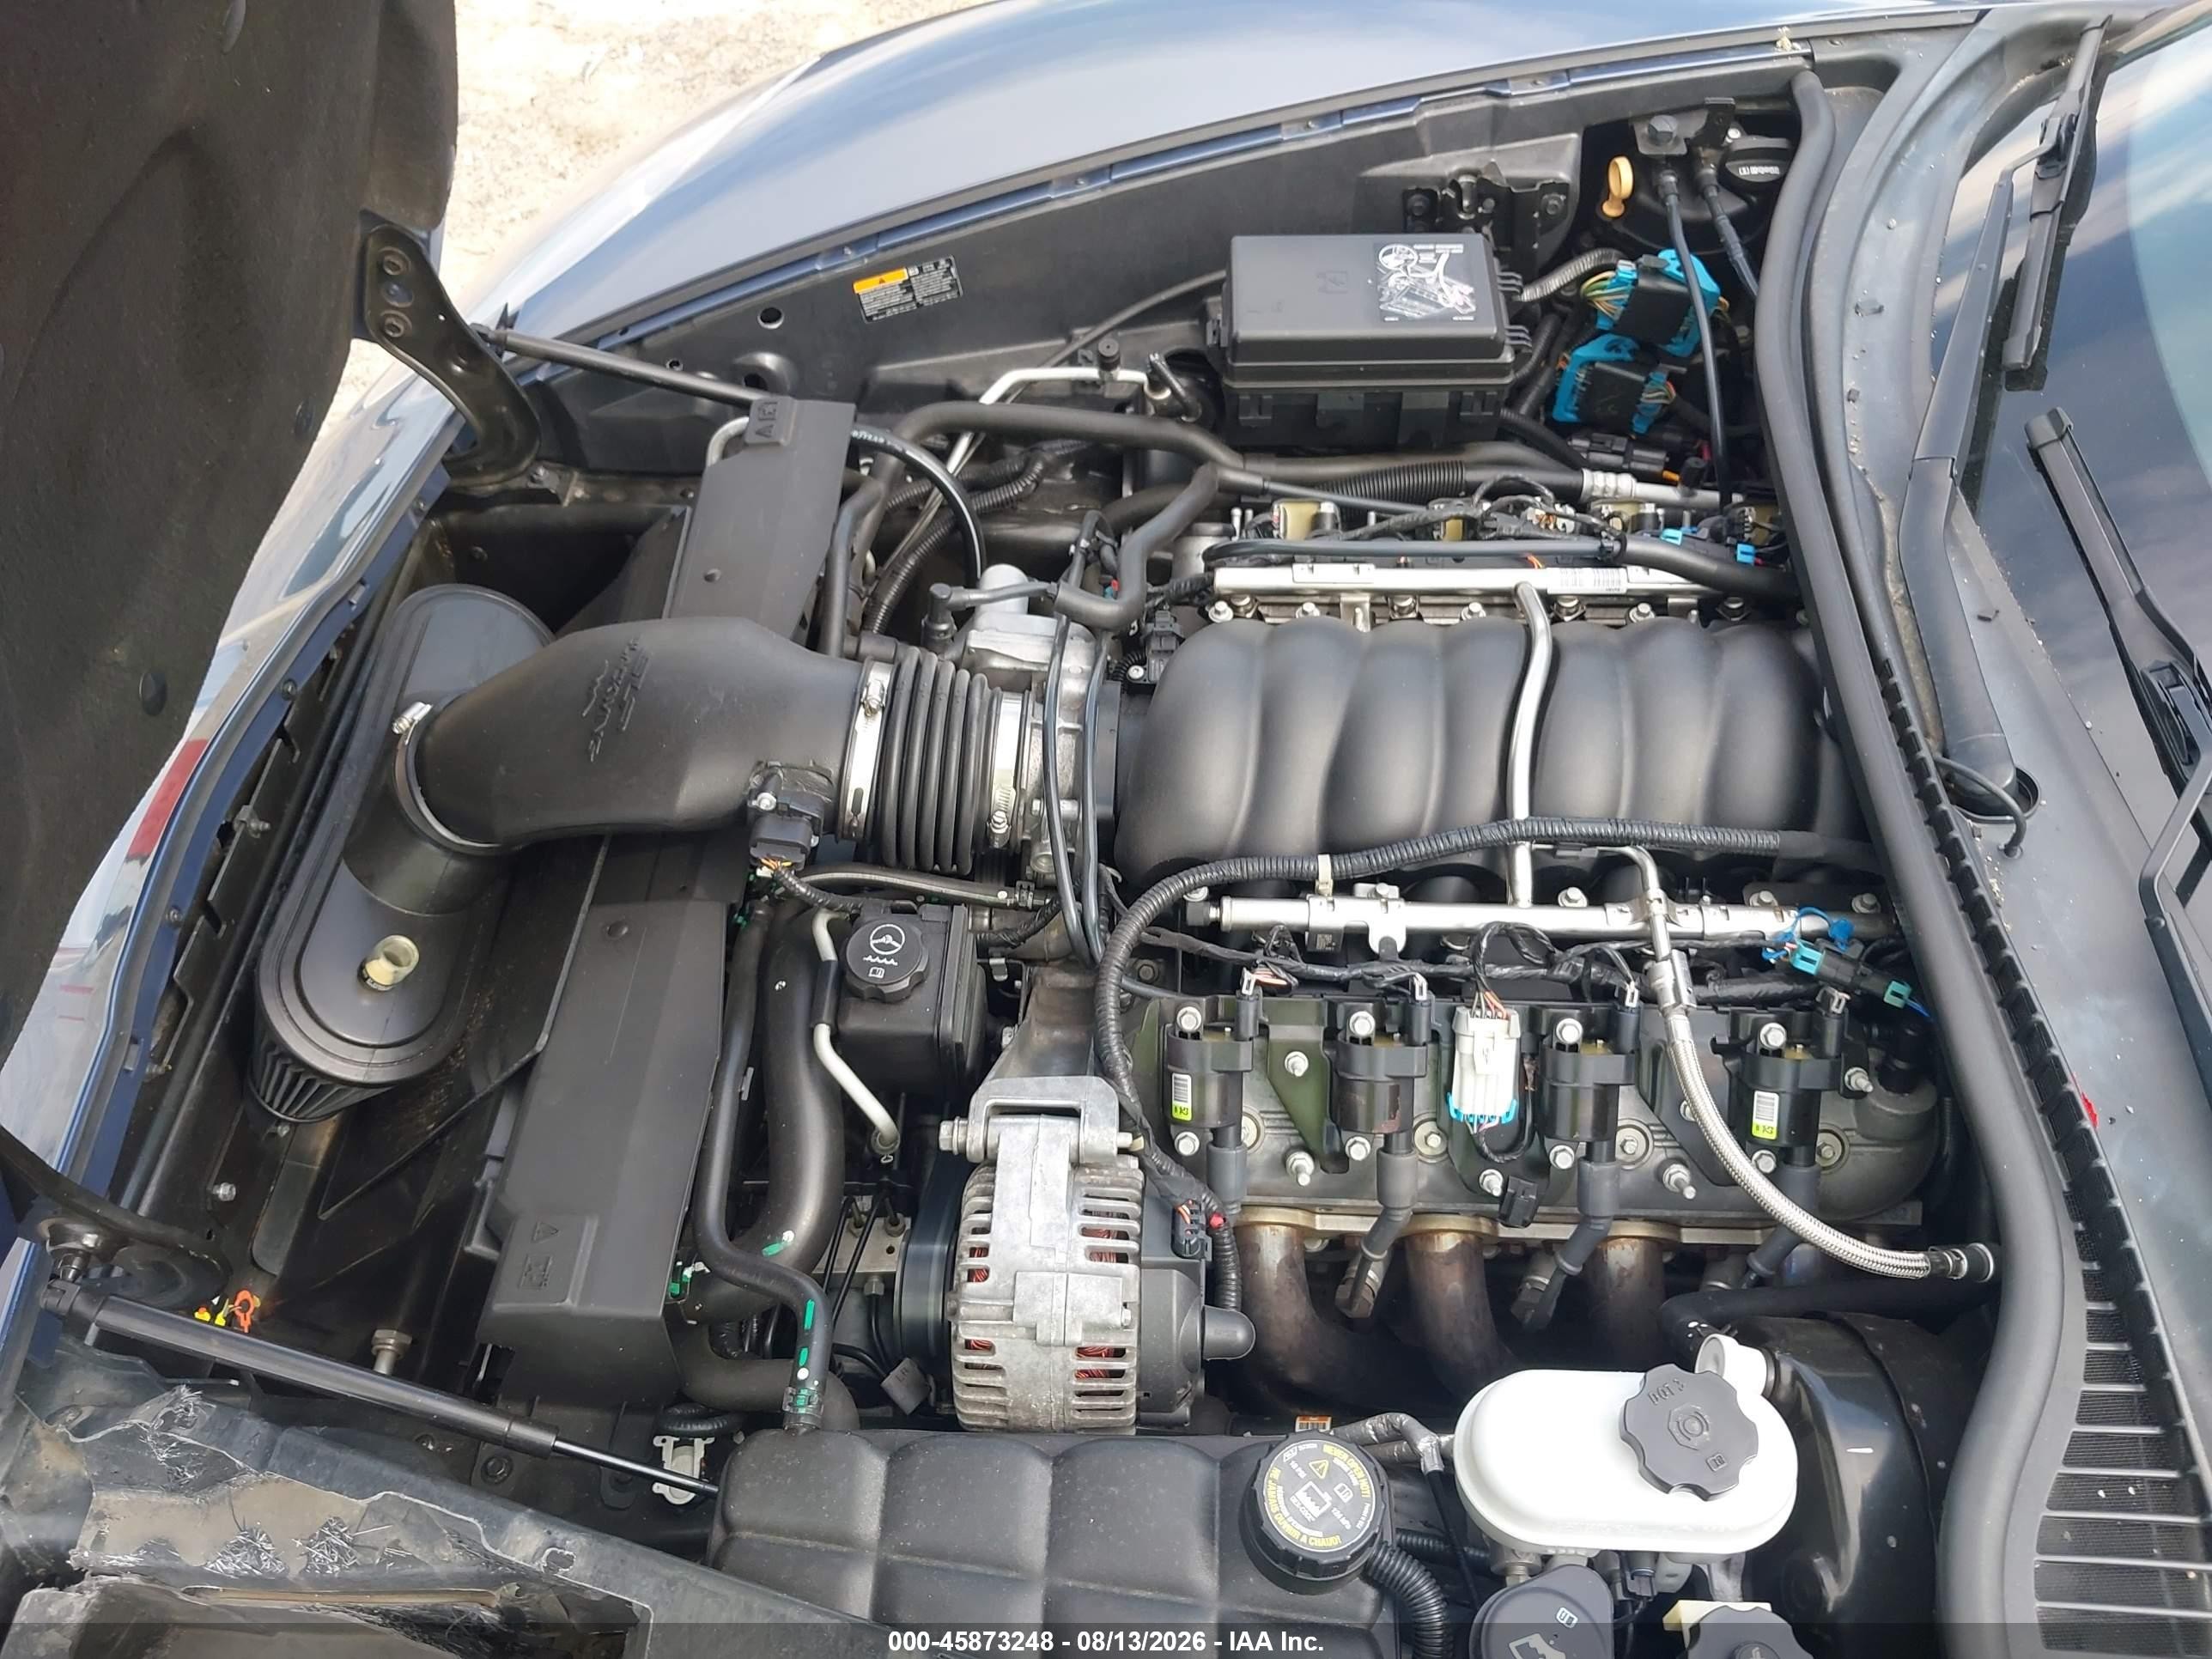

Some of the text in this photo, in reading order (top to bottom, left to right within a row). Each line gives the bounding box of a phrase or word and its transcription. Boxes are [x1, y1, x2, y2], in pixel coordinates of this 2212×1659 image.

[1269, 1467, 1281, 1480] NE
[1323, 1444, 1349, 1462] NEVER
[1346, 1458, 1365, 1479] OPEN
[1359, 1478, 1370, 1498] HOT!
[1267, 1479, 1279, 1513] JAMAIS
